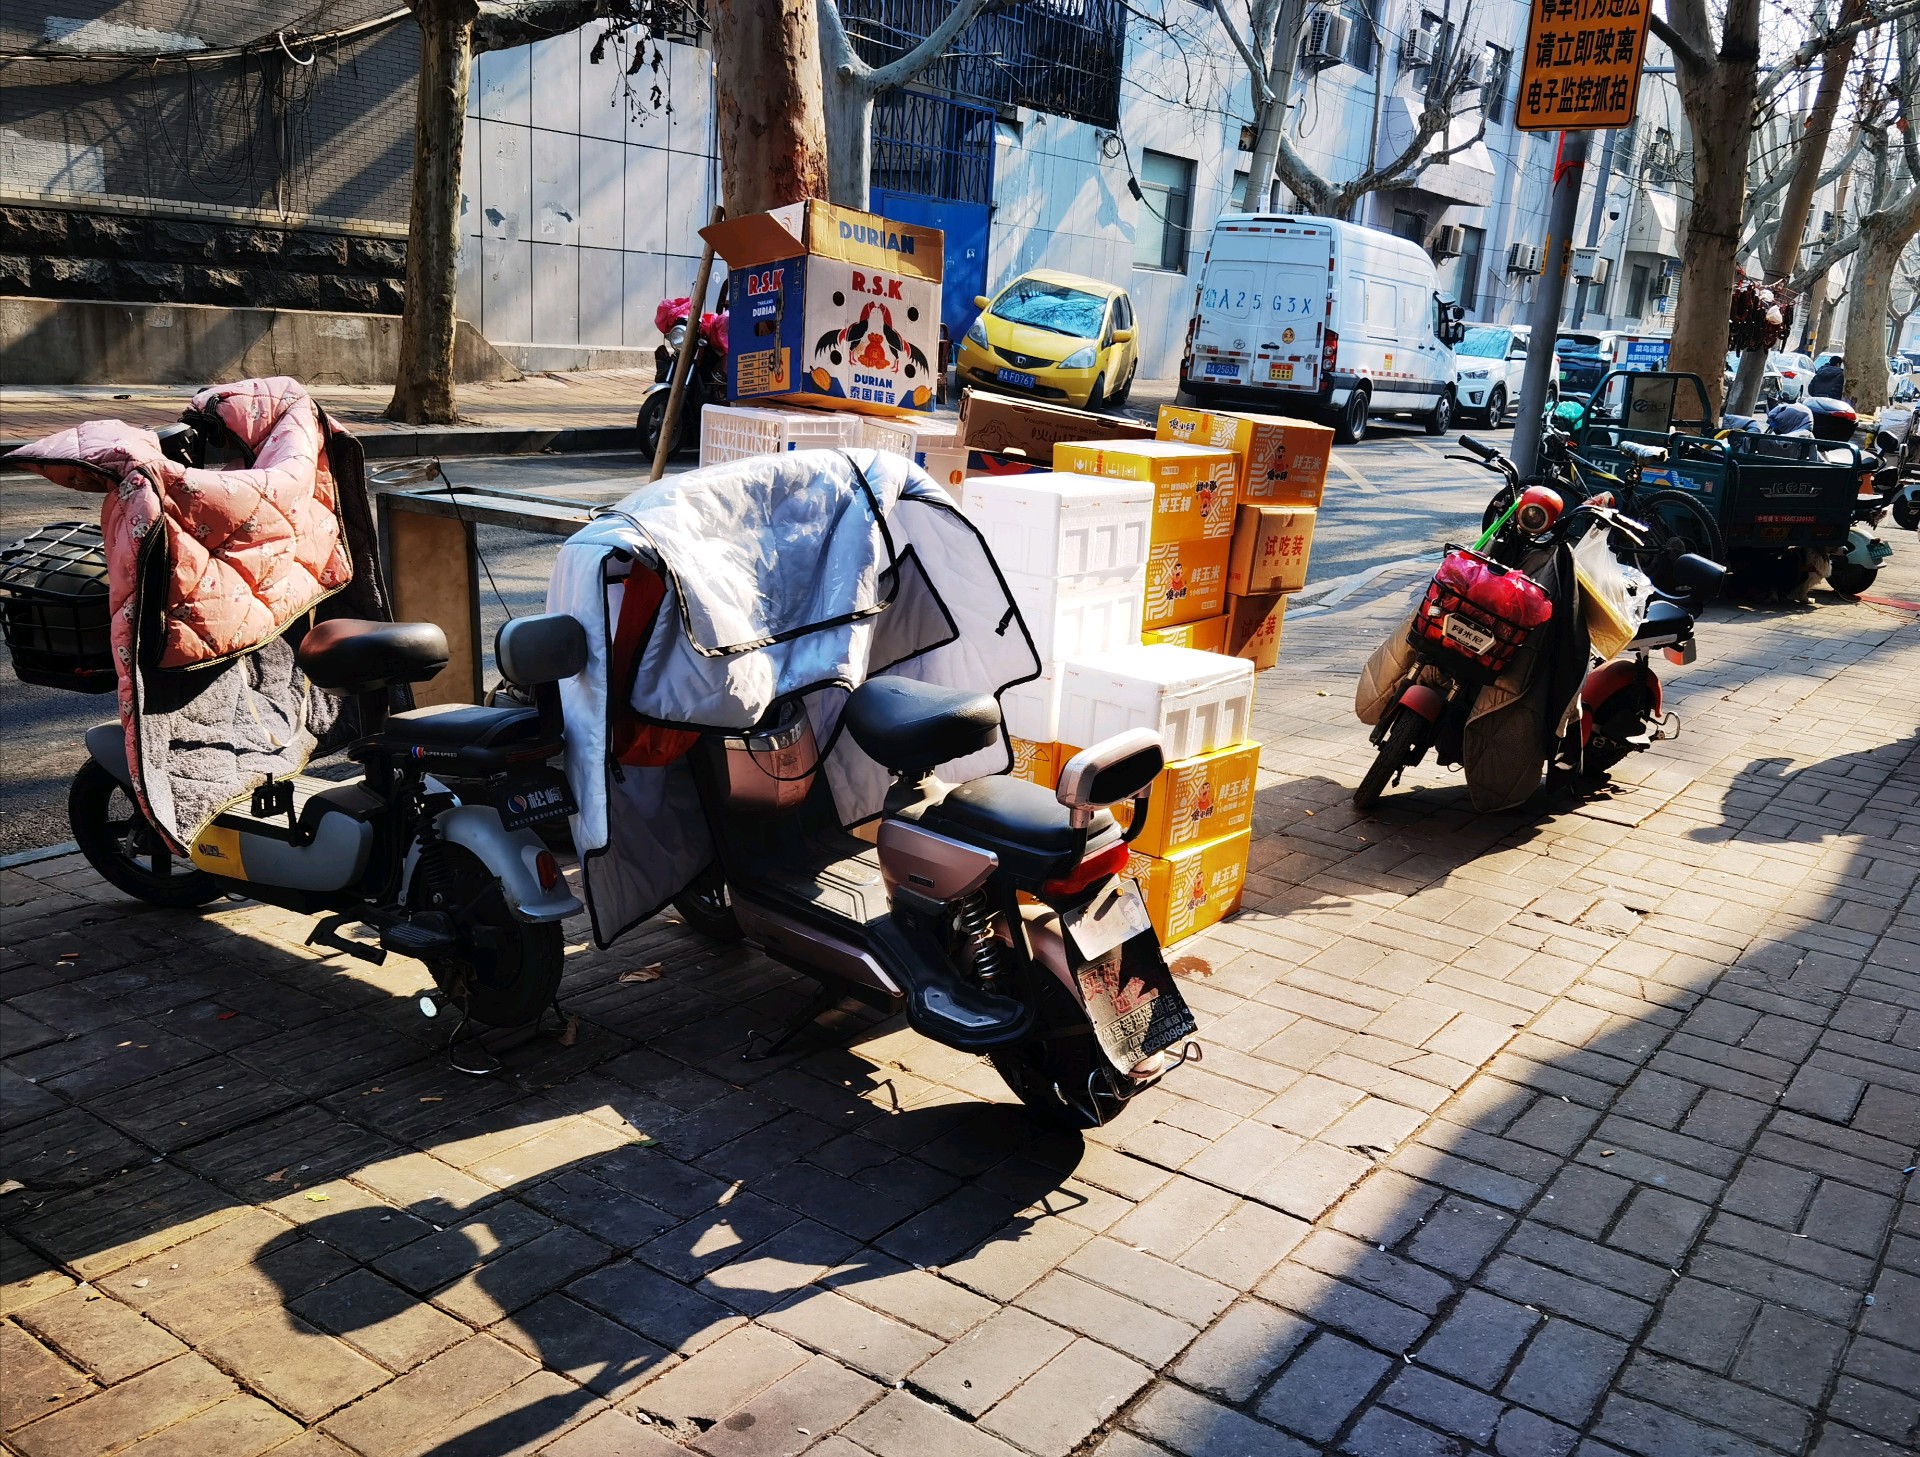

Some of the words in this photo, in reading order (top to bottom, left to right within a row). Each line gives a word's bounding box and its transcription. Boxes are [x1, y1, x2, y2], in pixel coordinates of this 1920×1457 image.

[1536, 26, 1637, 69] 请立即驶离
[1527, 74, 1629, 114] 电子监控抓拍
[839, 220, 915, 256] DURIAN
[748, 268, 785, 297] R.S.K
[851, 270, 903, 301] R.S.K
[854, 373, 893, 389] DURIAN
[850, 385, 896, 405] 泰国榴莲
[1265, 535, 1305, 557] 试吃装
[1191, 565, 1221, 583] 鲜玉米
[1451, 624, 1484, 646] 阿米尼
[1218, 776, 1250, 799] 鲜玉米
